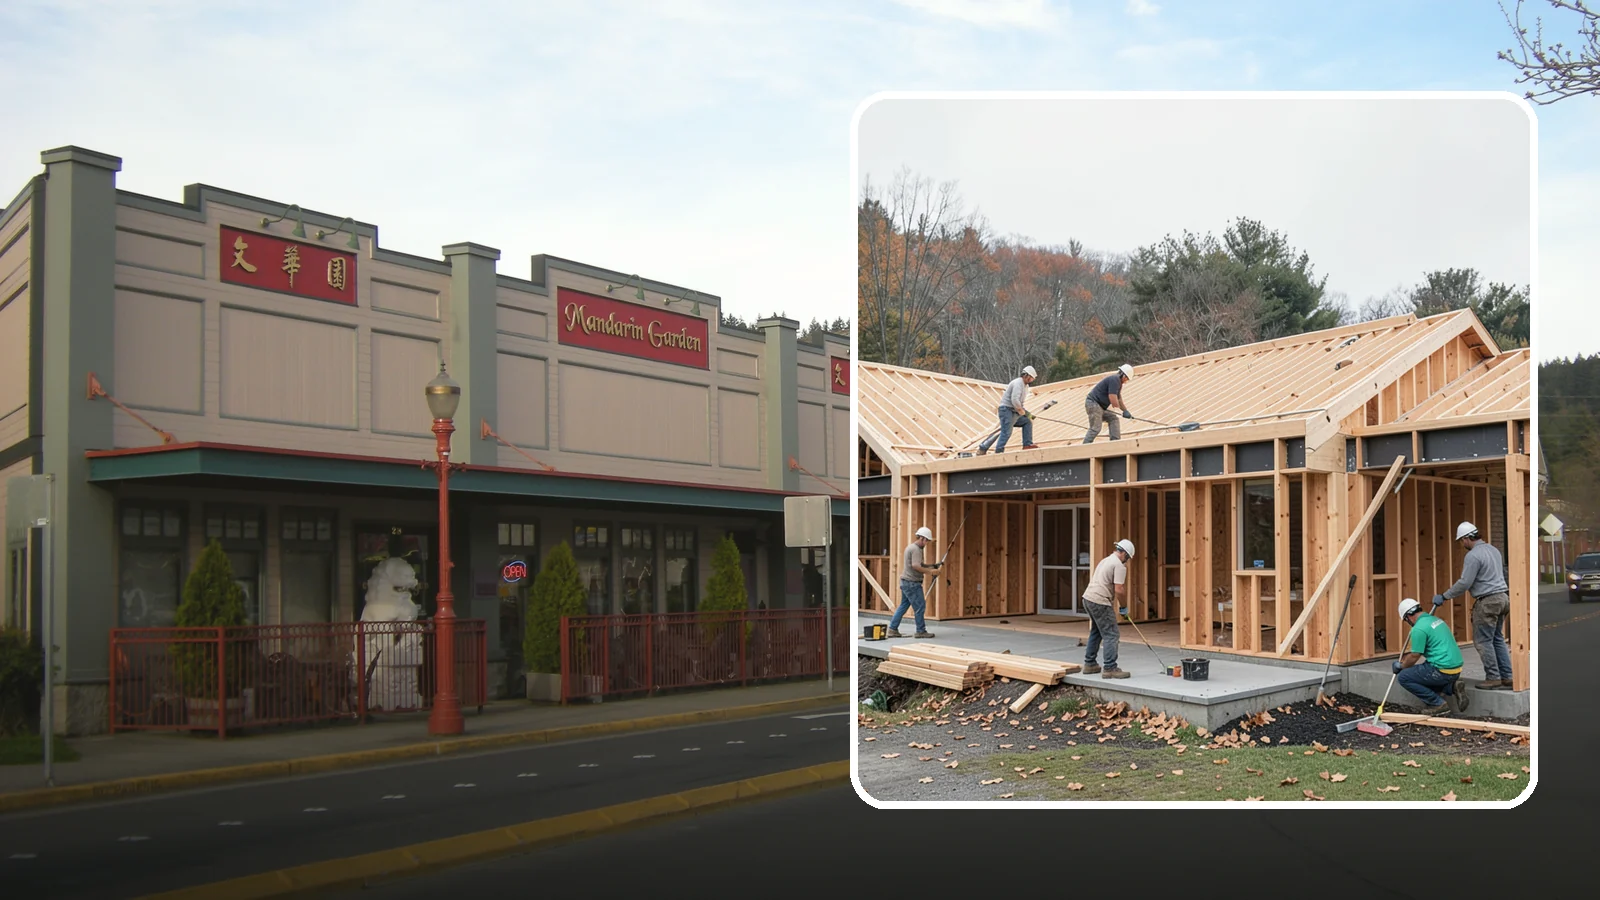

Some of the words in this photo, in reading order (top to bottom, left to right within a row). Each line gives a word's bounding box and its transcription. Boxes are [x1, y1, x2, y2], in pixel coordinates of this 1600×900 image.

[564, 302, 644, 341] Mandarin
[647, 320, 701, 352] Garden
[503, 565, 527, 578] OPEN
